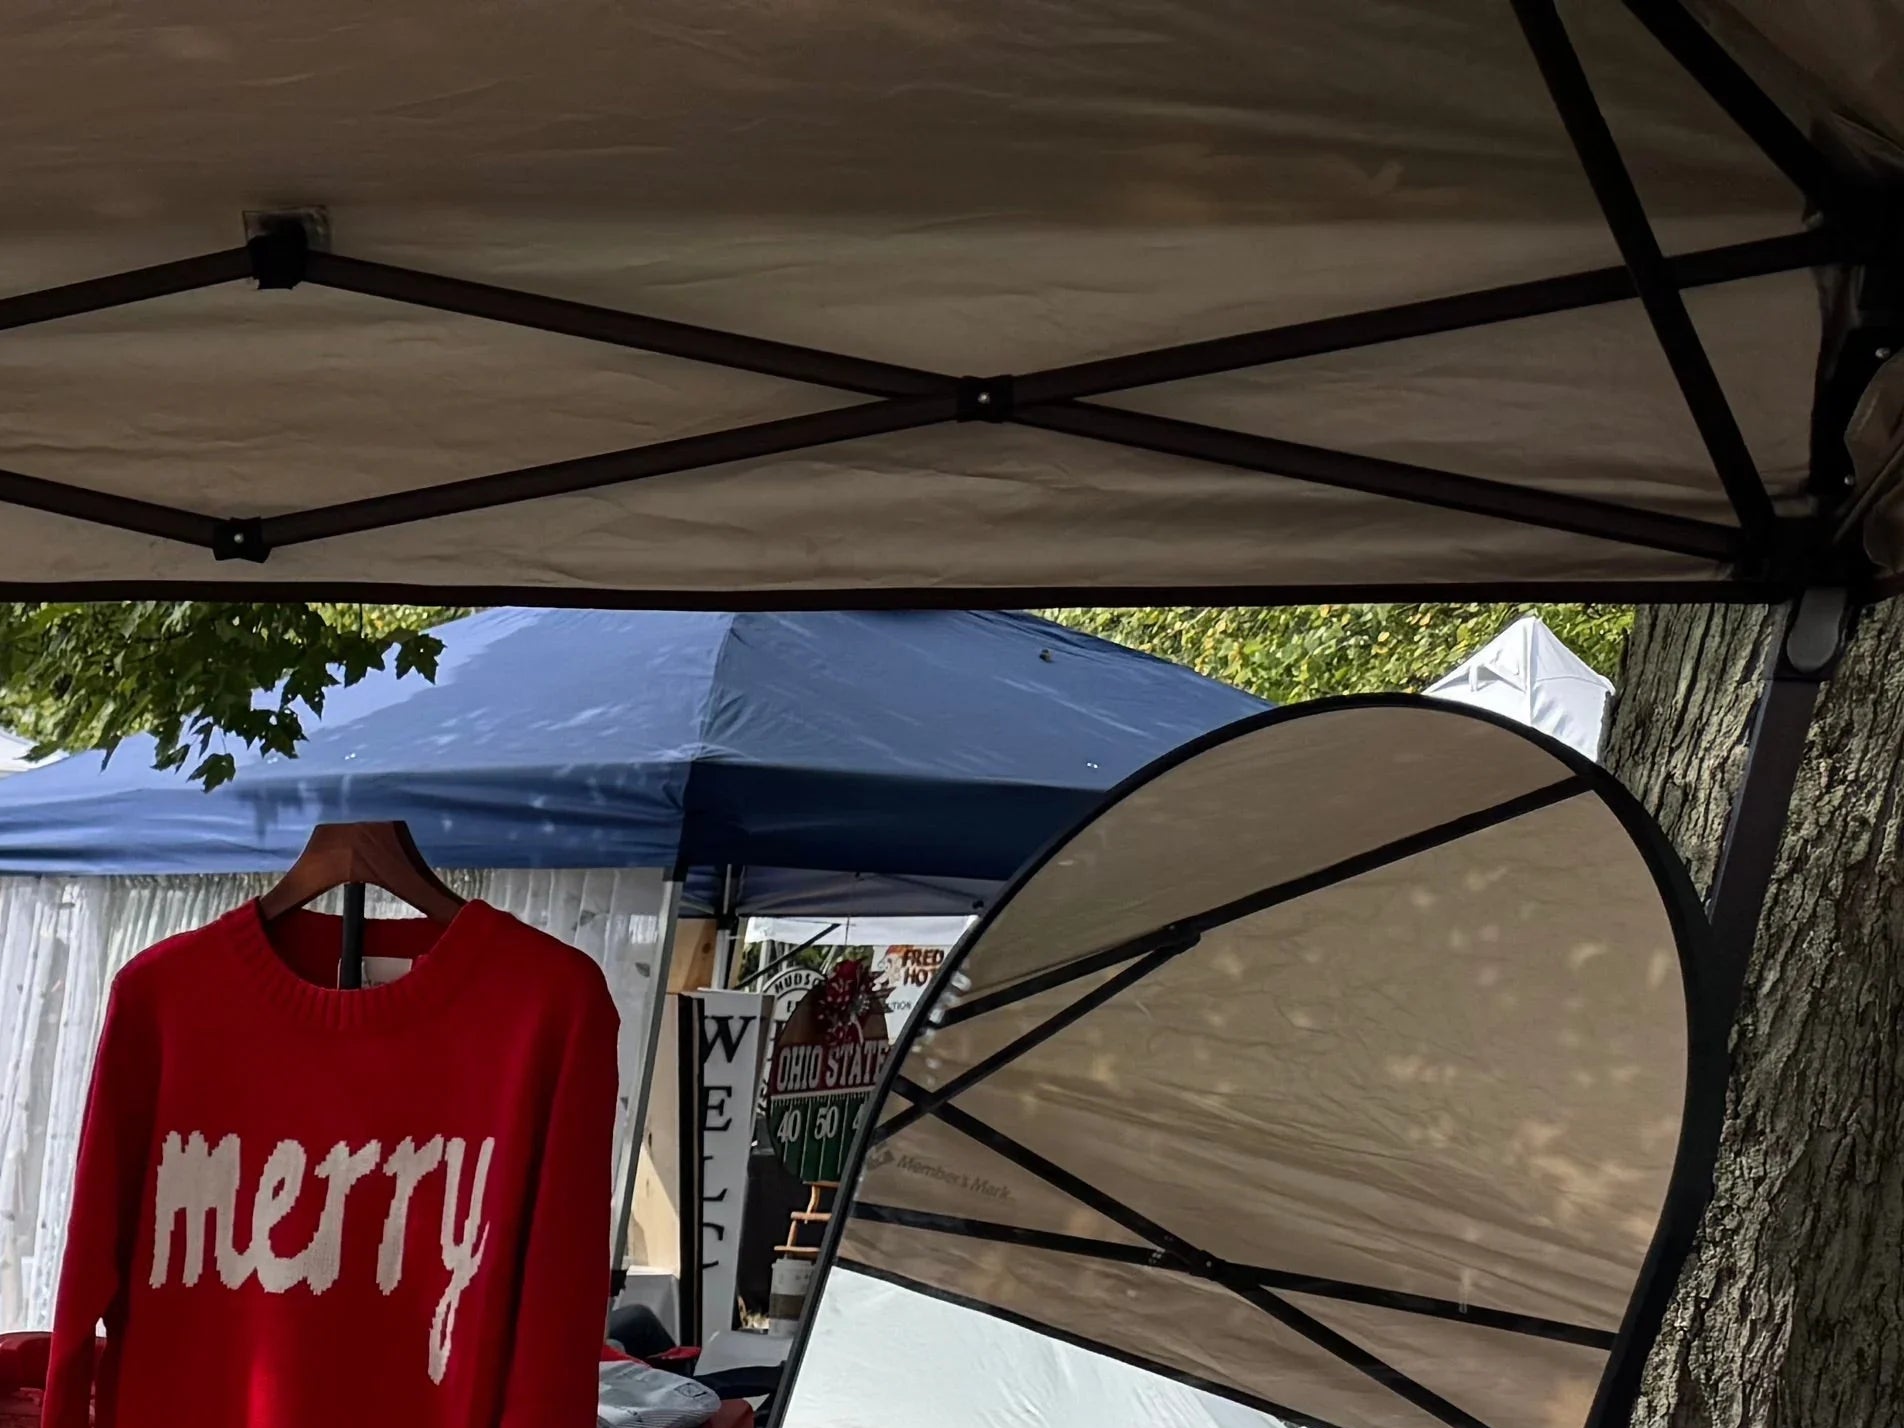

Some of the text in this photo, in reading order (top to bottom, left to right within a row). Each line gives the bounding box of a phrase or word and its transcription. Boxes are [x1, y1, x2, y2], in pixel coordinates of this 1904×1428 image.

[777, 1038, 889, 1093] OHIO STATE
[776, 1109, 803, 1145] 40
[813, 1105, 840, 1140] 50
[148, 1129, 495, 1385] merry
